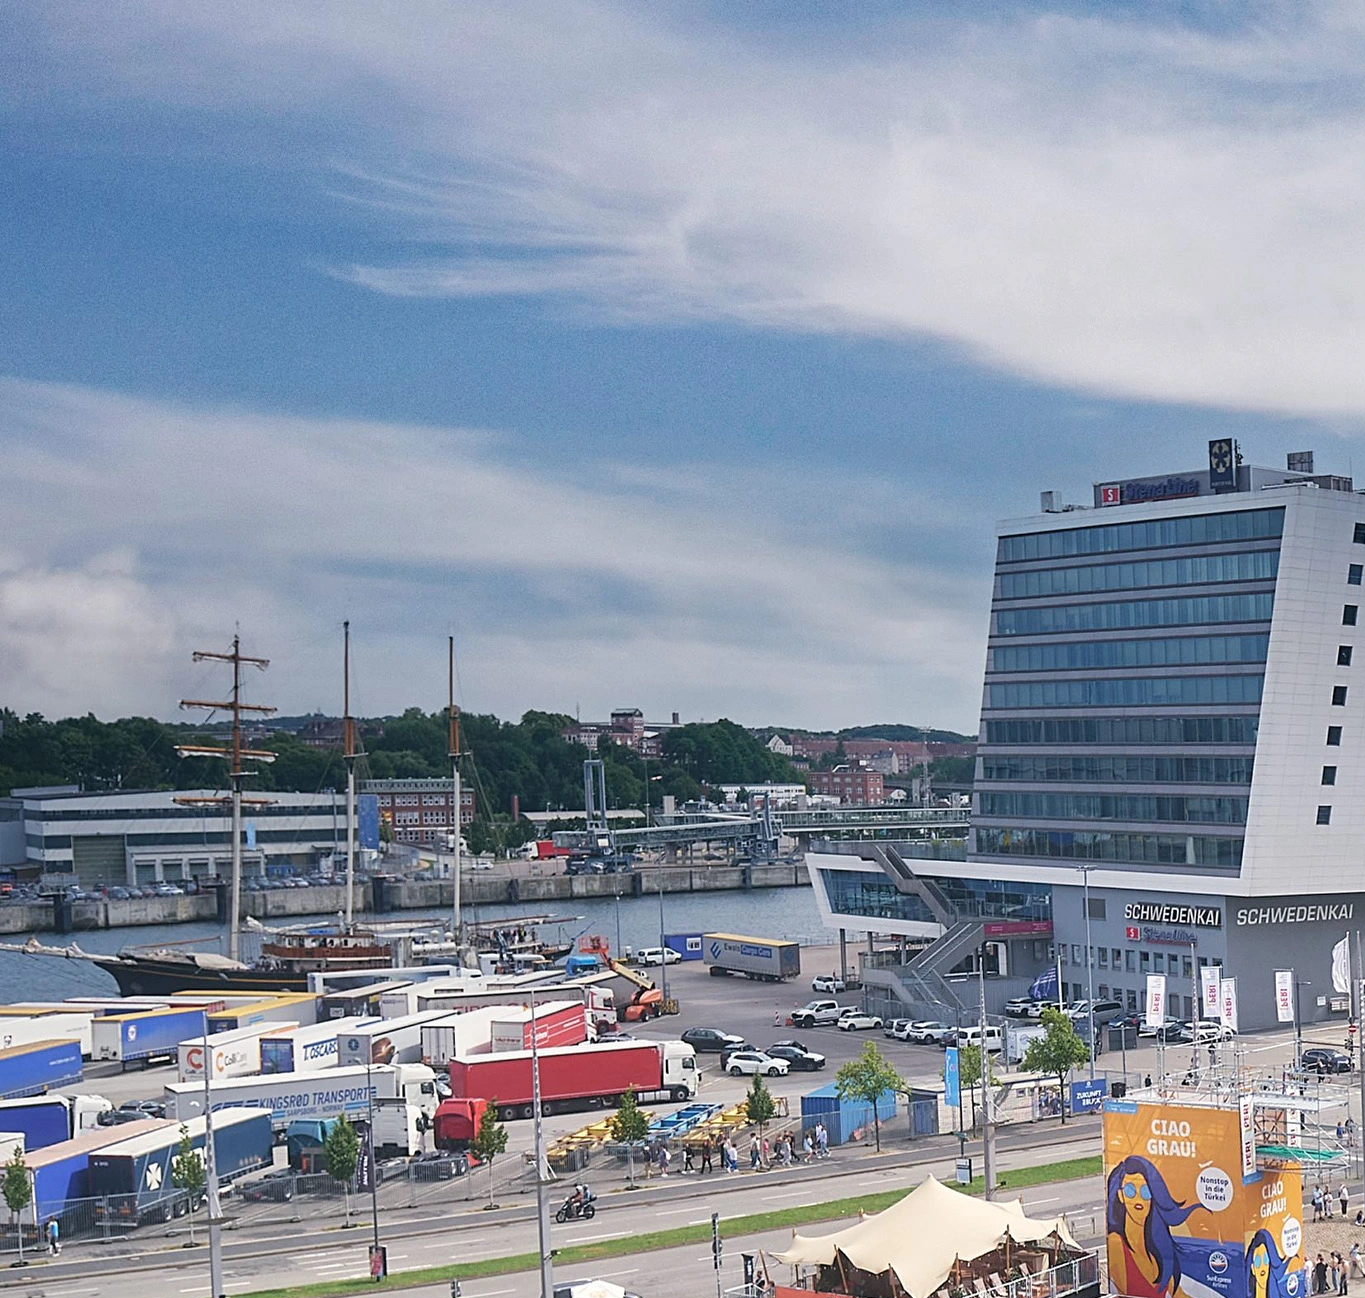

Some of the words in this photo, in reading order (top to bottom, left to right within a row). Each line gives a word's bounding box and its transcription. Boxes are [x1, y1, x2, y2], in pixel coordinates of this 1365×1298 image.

[1124, 903, 1222, 927] SCHWEDENKAI
[1237, 903, 1354, 926] SCHWEDENKAI
[257, 1093, 309, 1110] KINGSRØD
[312, 1087, 368, 1106] TRANSPORT
[1150, 1118, 1191, 1138] CIAO
[1146, 1138, 1197, 1158] GRAU!
[1200, 1175, 1229, 1187] Nonstop
[1205, 1185, 1211, 1193] in
[1213, 1186, 1224, 1194] die
[1261, 1180, 1284, 1200] CIAO
[1204, 1192, 1226, 1203] Türkei
[1259, 1199, 1288, 1219] GRAU!
